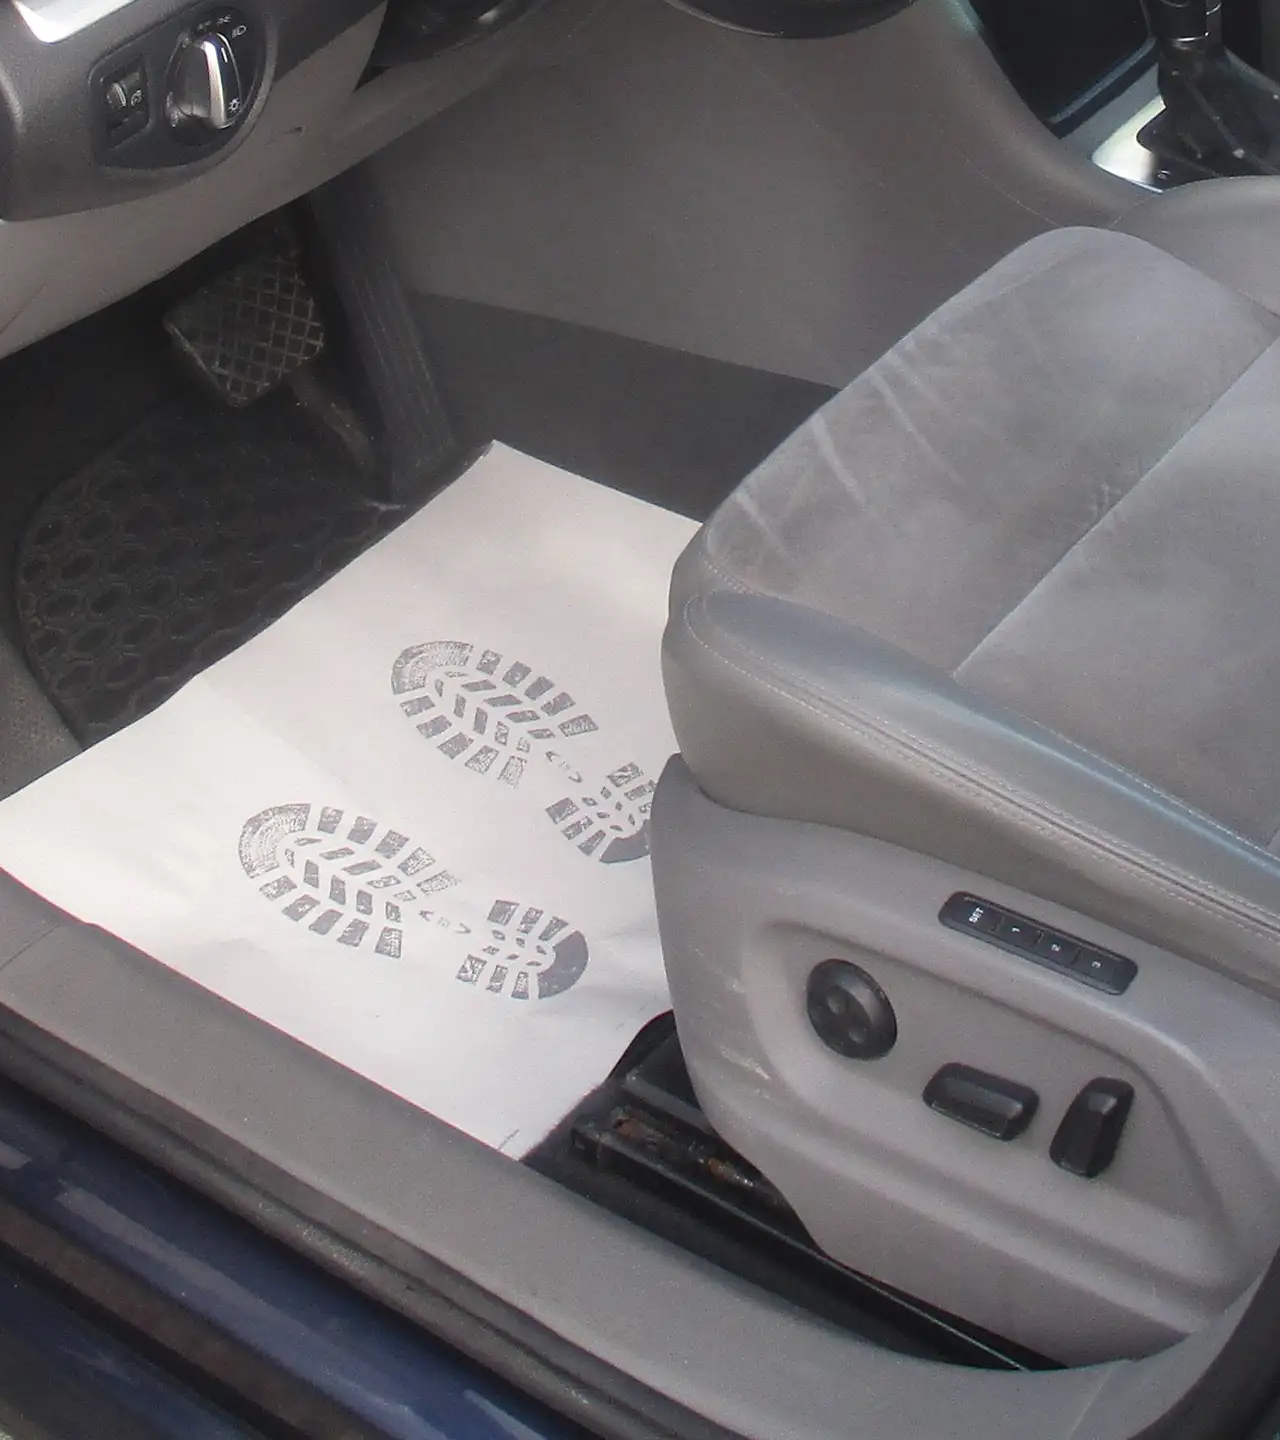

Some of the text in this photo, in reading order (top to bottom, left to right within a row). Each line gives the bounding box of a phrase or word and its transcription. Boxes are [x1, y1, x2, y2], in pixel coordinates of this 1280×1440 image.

[969, 907, 984, 923] SET
[1051, 943, 1061, 952] 2
[1092, 960, 1101, 969] 3
